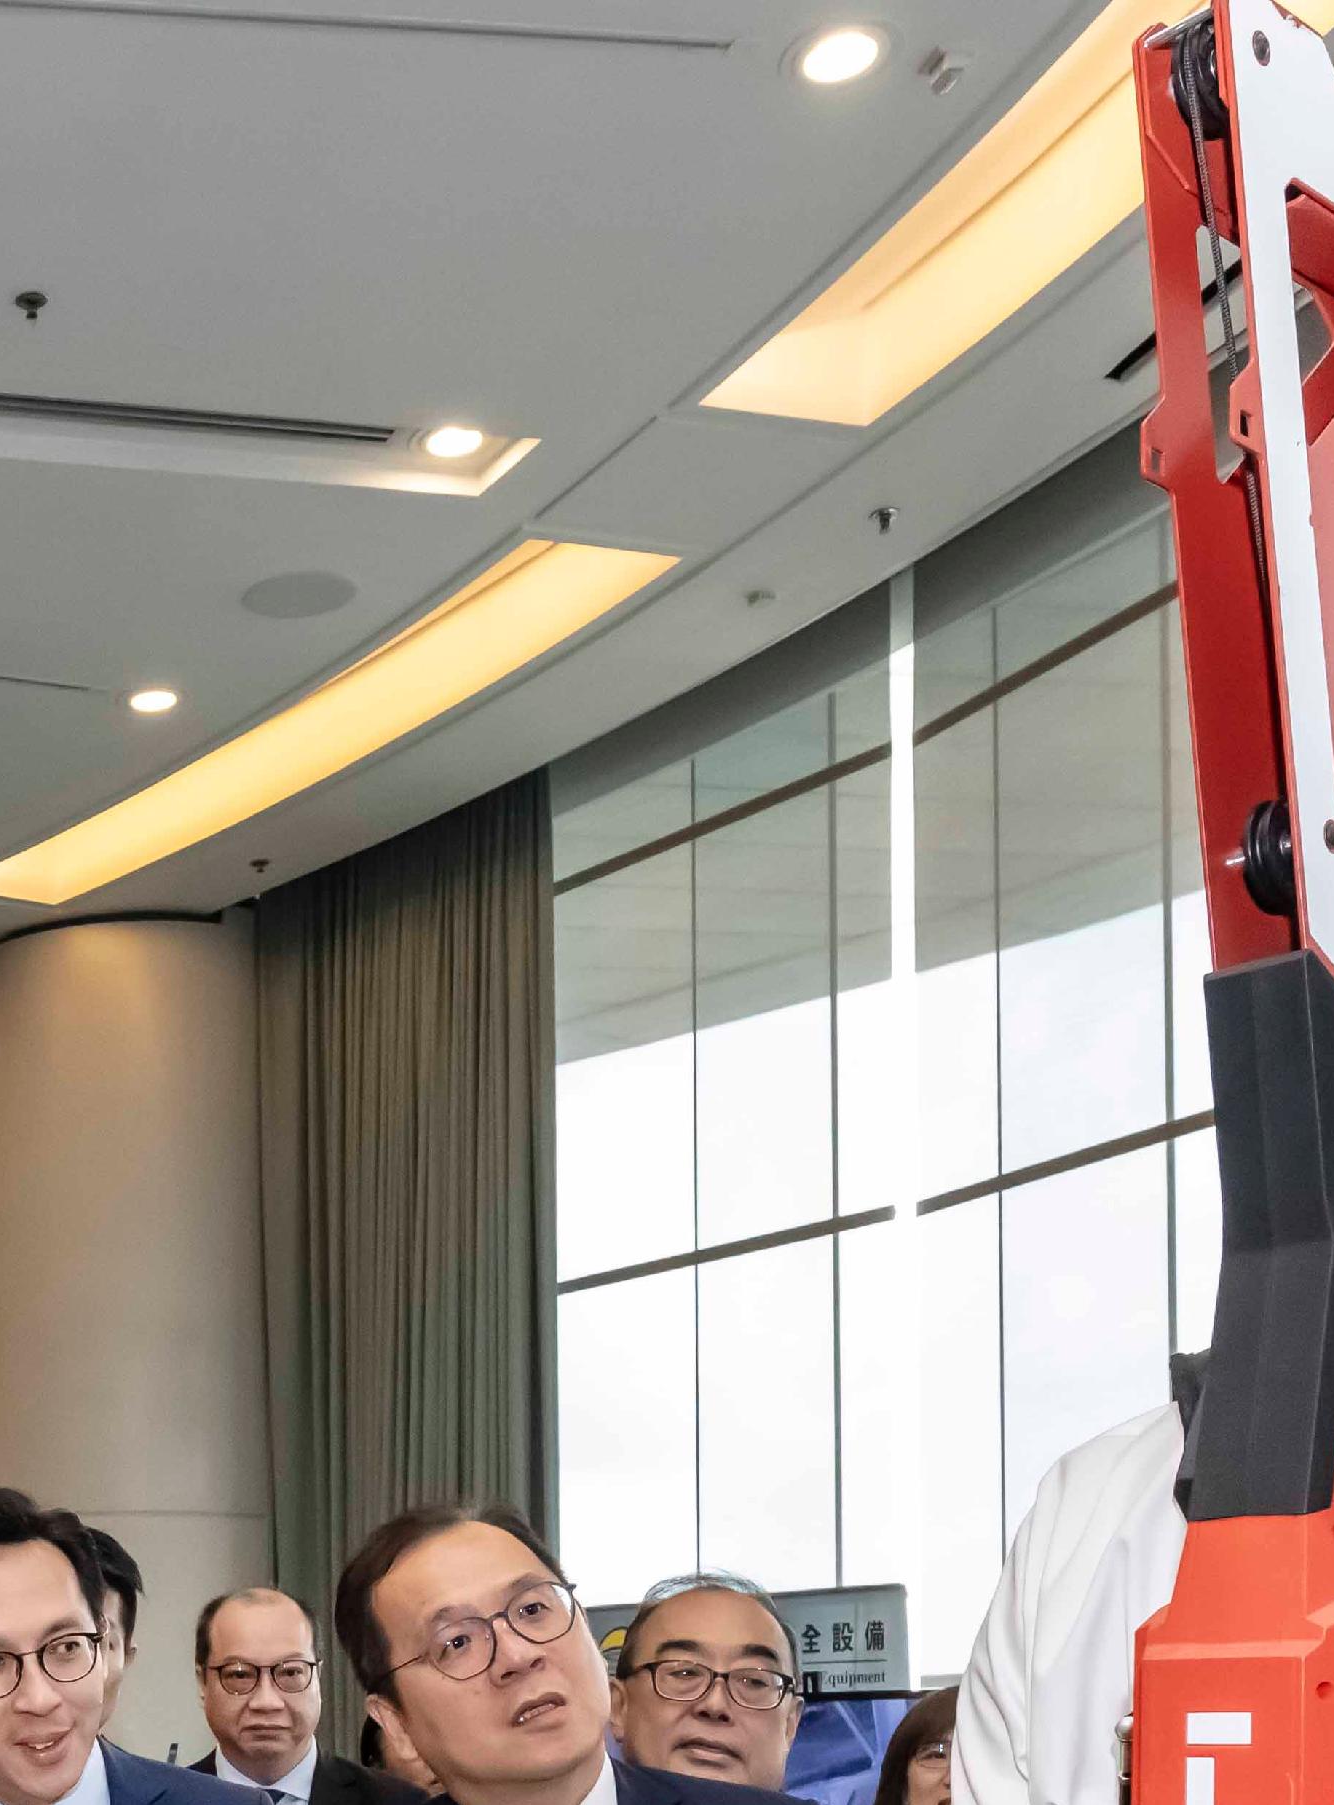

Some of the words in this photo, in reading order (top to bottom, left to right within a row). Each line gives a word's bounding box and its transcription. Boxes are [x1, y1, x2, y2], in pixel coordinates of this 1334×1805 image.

[801, 1620, 885, 1654] 全設備
[825, 1670, 886, 1687] quipment
